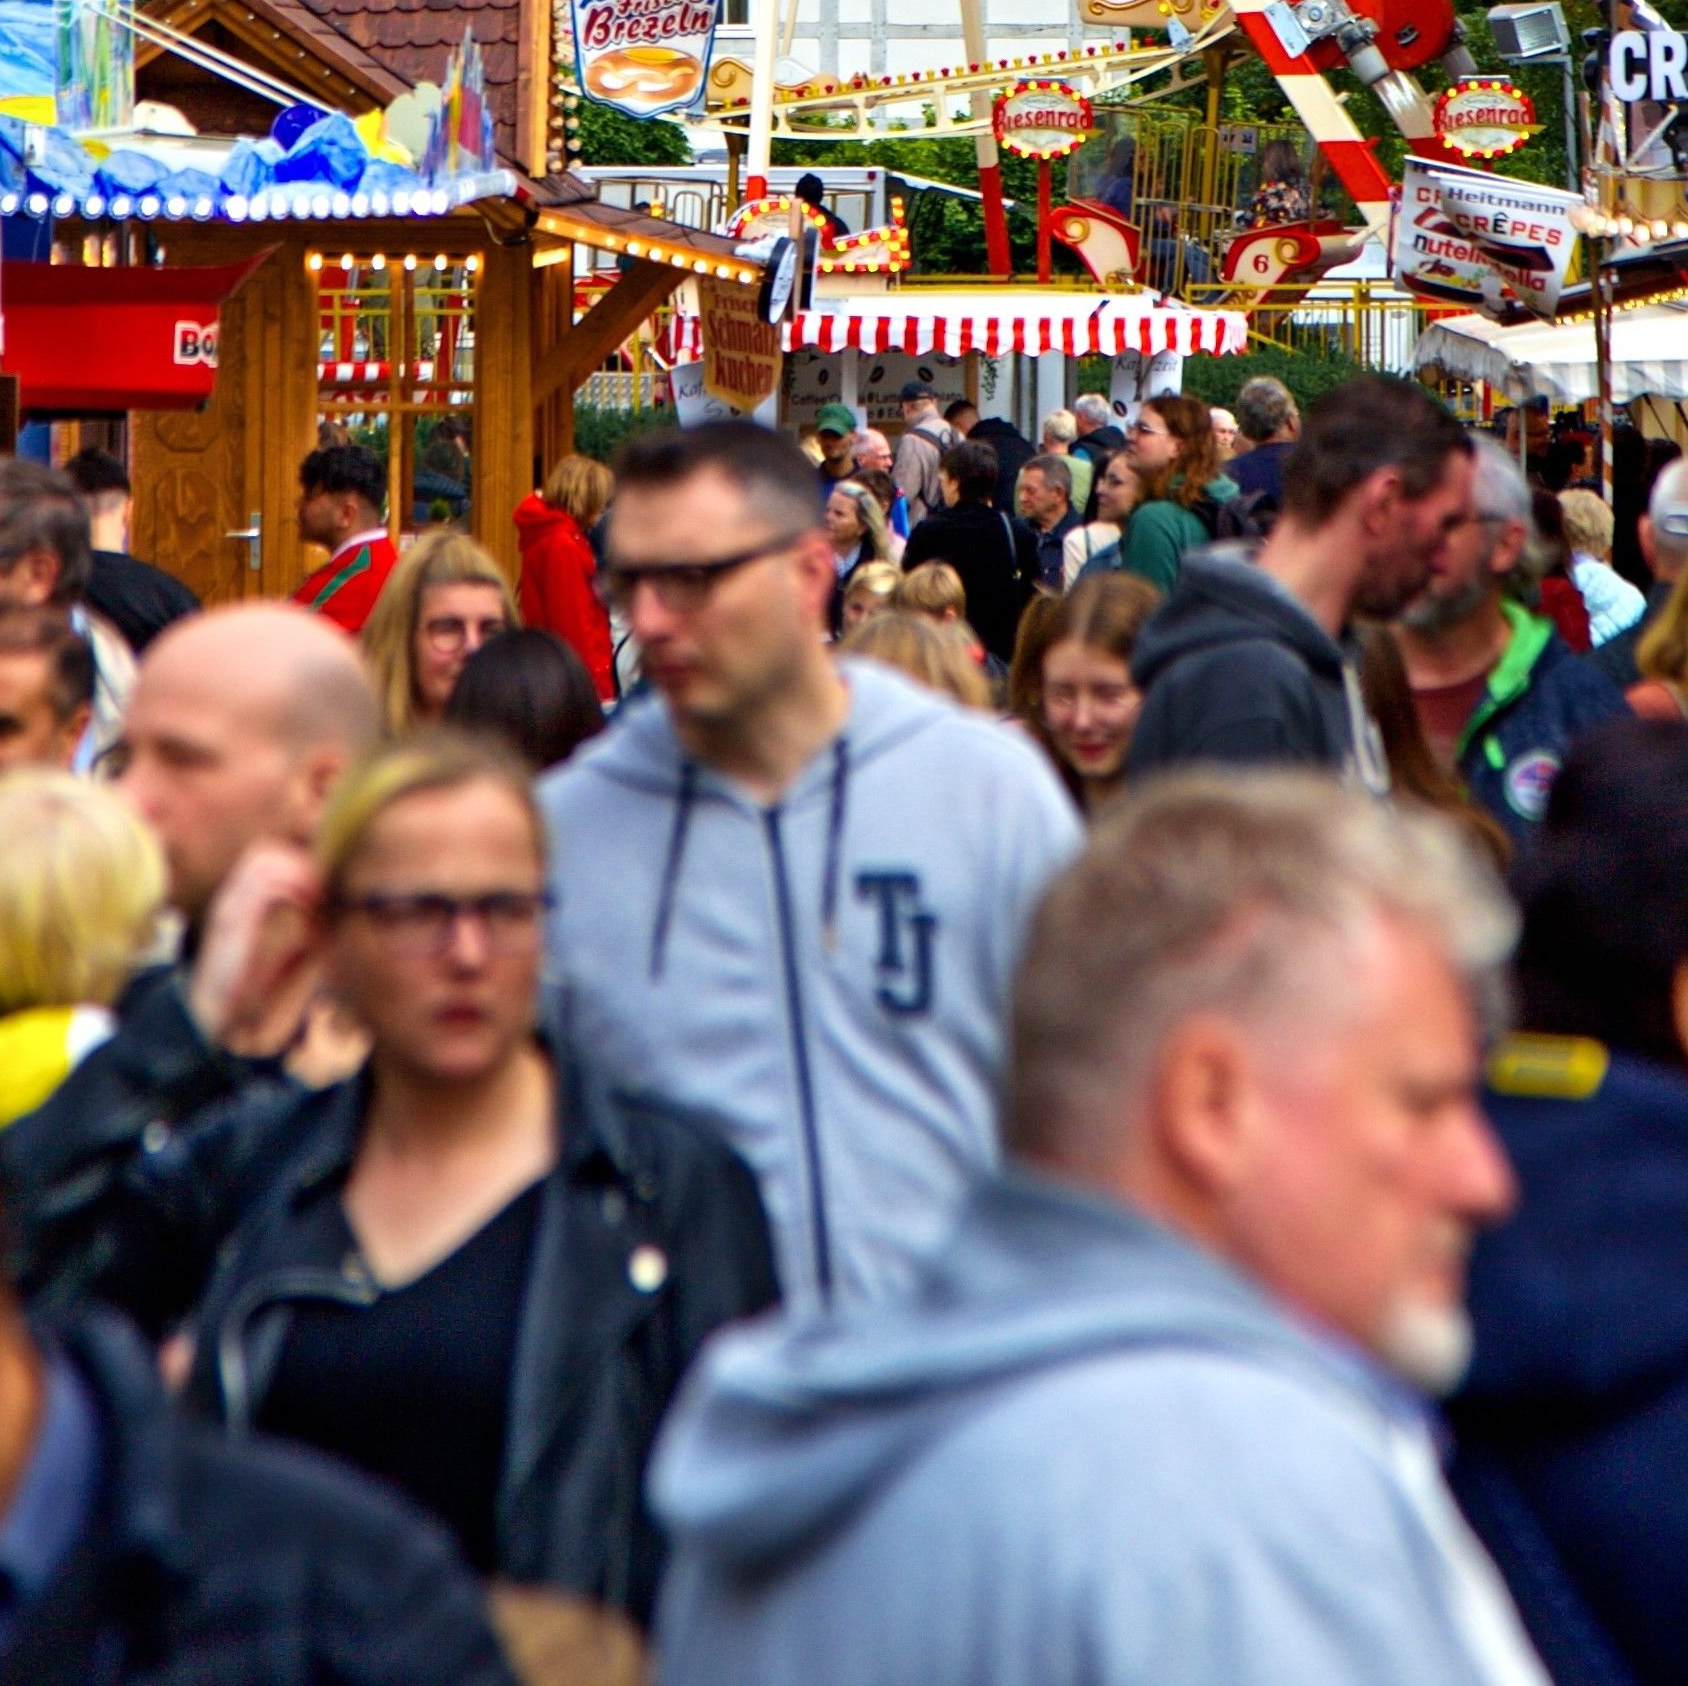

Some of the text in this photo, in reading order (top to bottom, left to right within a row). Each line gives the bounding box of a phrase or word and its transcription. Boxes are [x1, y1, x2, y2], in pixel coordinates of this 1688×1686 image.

[583, 2, 710, 46] Brezeln
[1447, 187, 1566, 215] Heitmann
[1455, 212, 1562, 246] CRÊPES
[1253, 255, 1269, 274] 6
[1414, 234, 1490, 266] nutell
